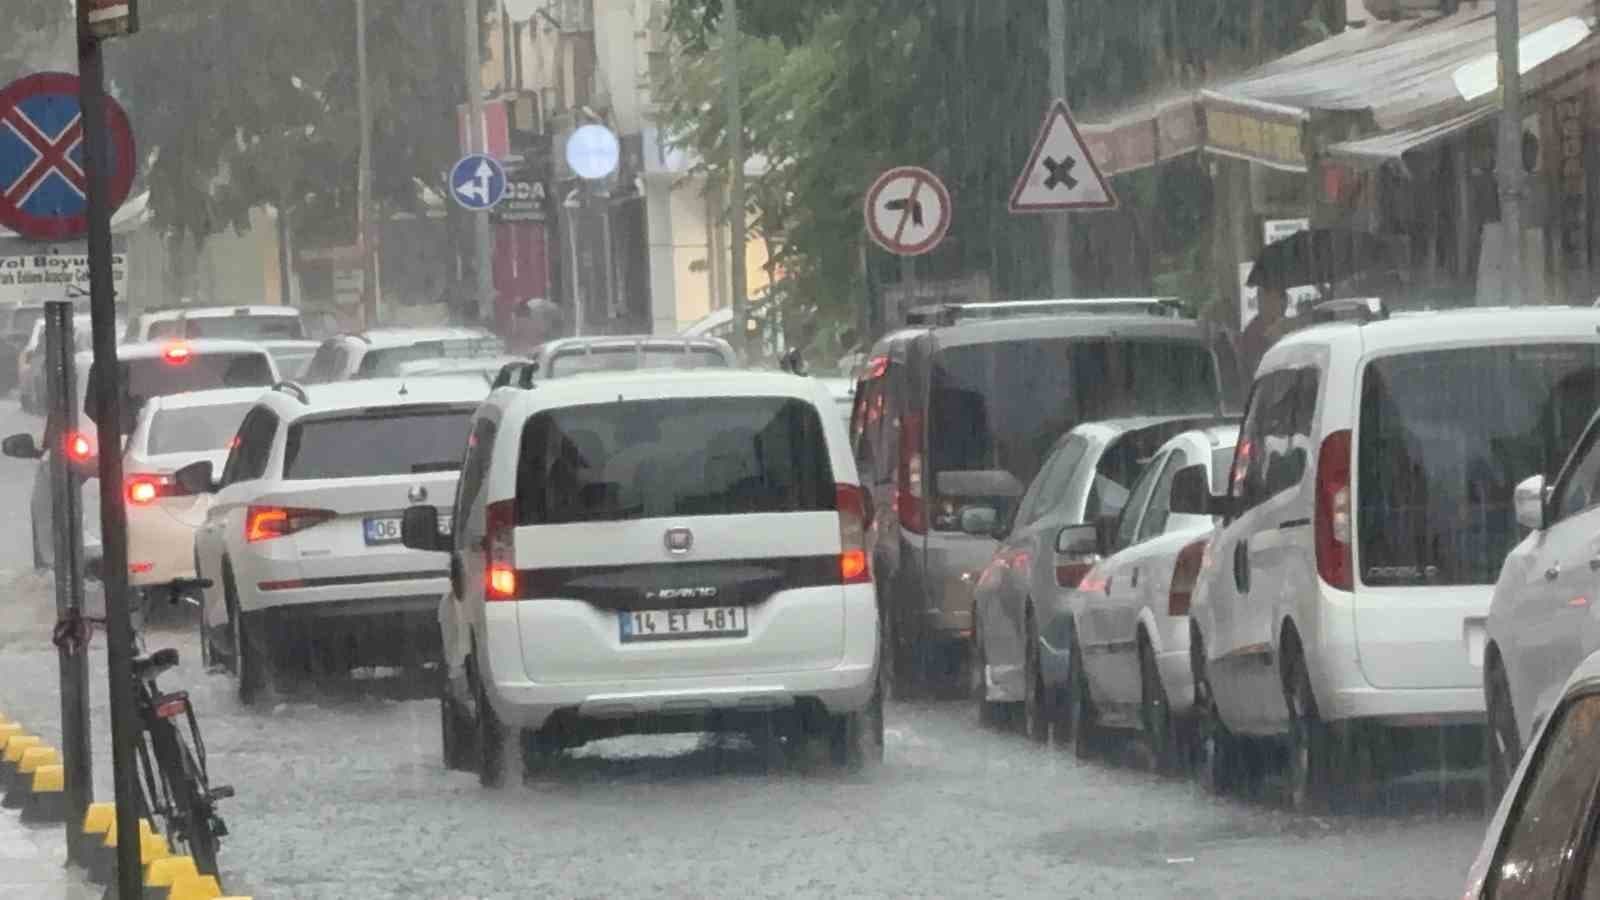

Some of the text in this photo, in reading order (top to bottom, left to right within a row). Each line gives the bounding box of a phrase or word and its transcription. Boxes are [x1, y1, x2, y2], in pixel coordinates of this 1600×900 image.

[376, 520, 397, 537] 06
[635, 612, 656, 633] 14
[668, 609, 690, 631] ET
